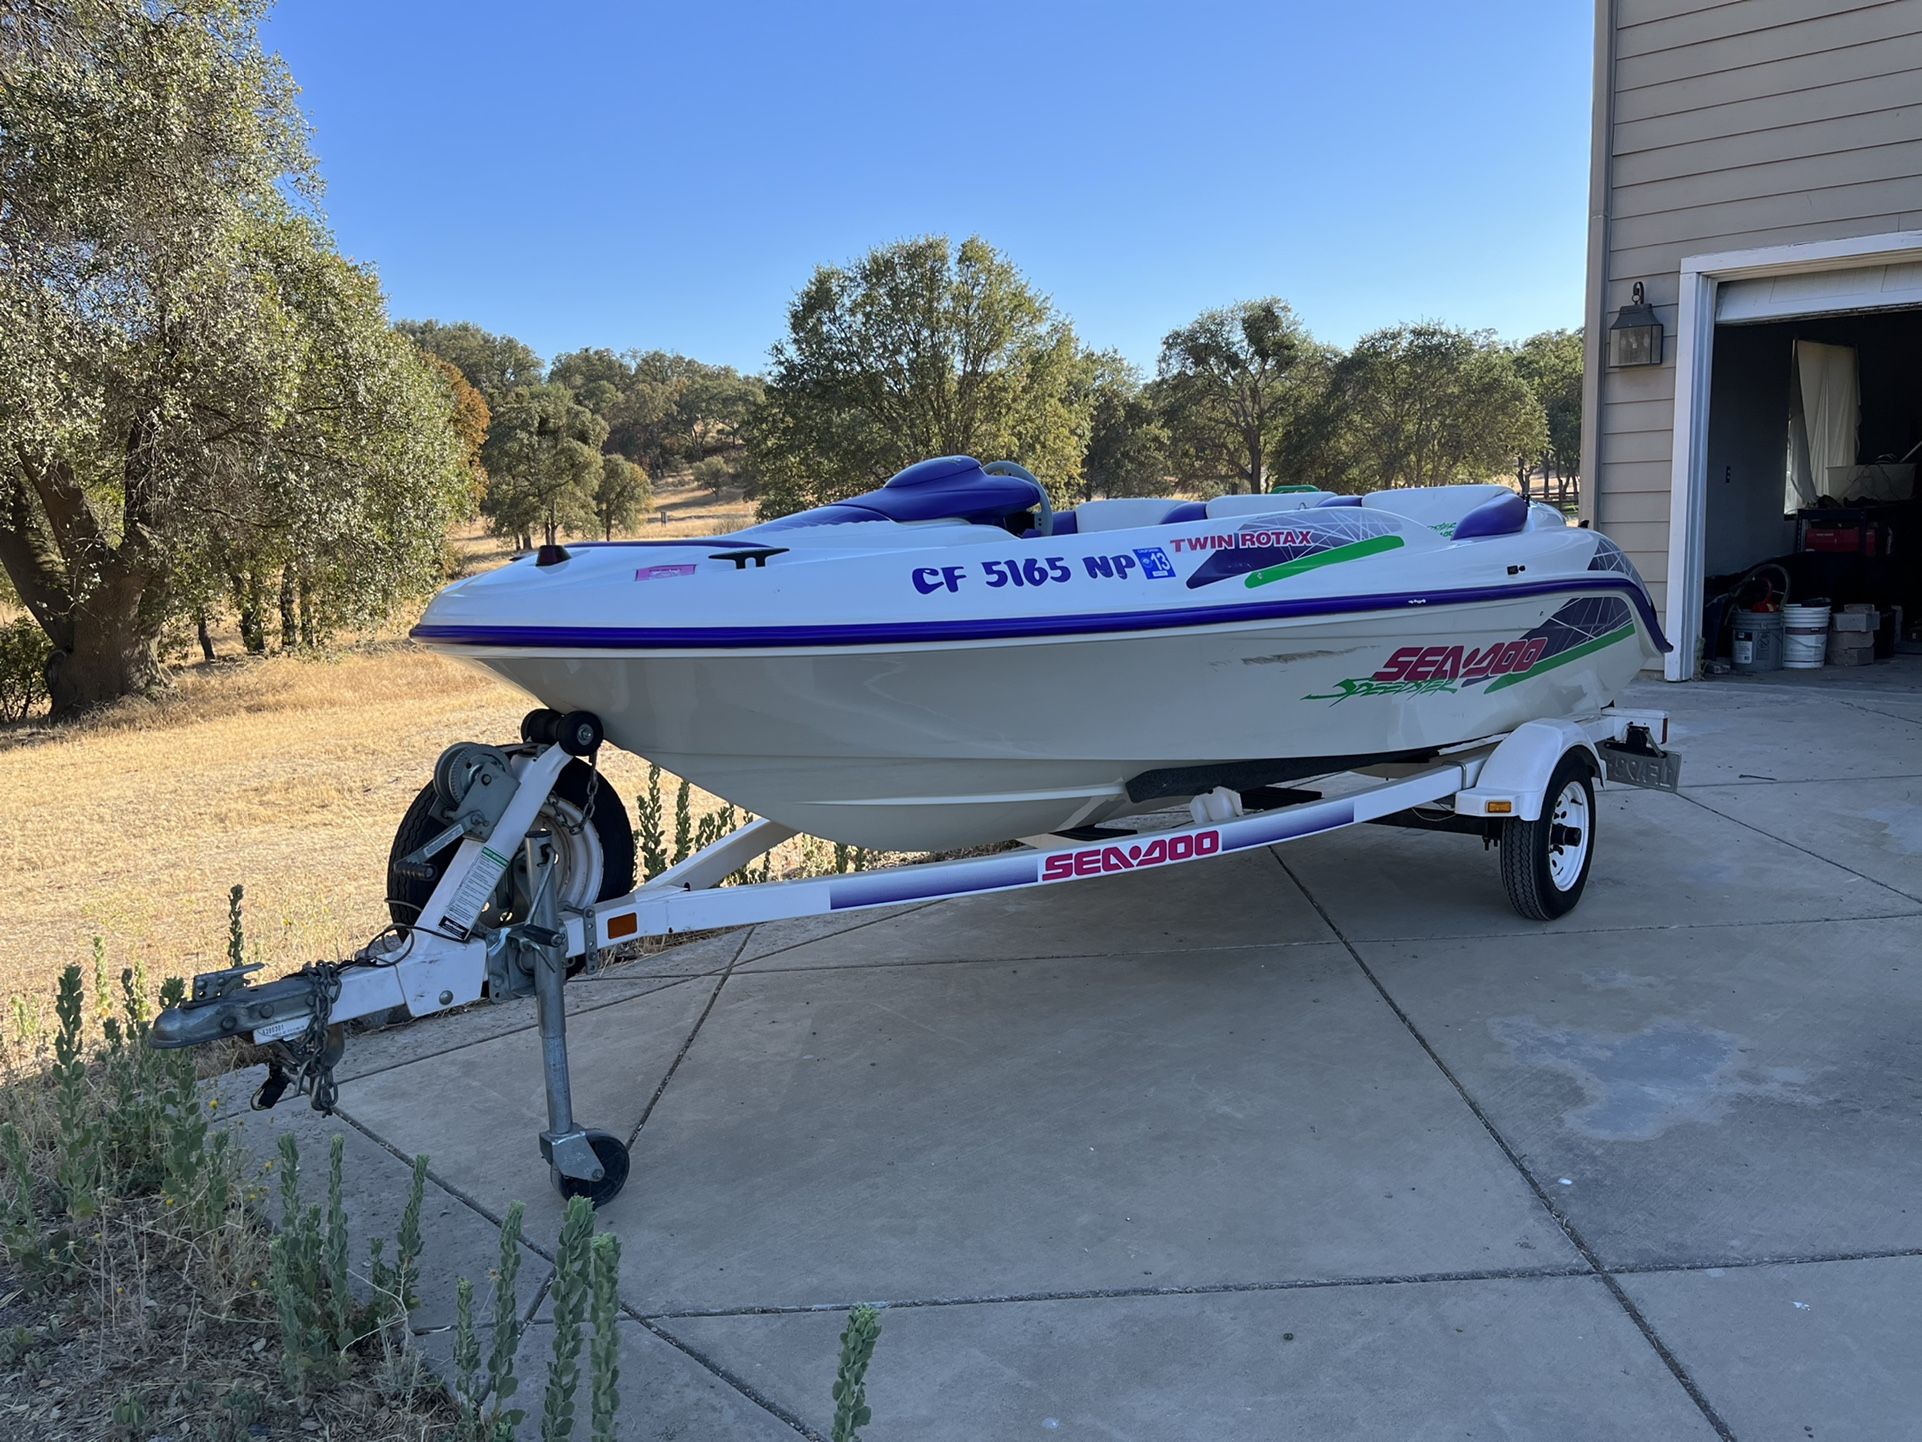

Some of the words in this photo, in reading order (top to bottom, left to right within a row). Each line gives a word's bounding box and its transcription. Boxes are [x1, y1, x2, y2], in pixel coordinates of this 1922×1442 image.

[1170, 534, 1234, 552] TWIN
[1240, 530, 1312, 548] ROTAX
[1150, 552, 1170, 571] 13
[912, 566, 966, 595] CF
[981, 556, 1072, 588] 5165
[1081, 554, 1136, 580] NP
